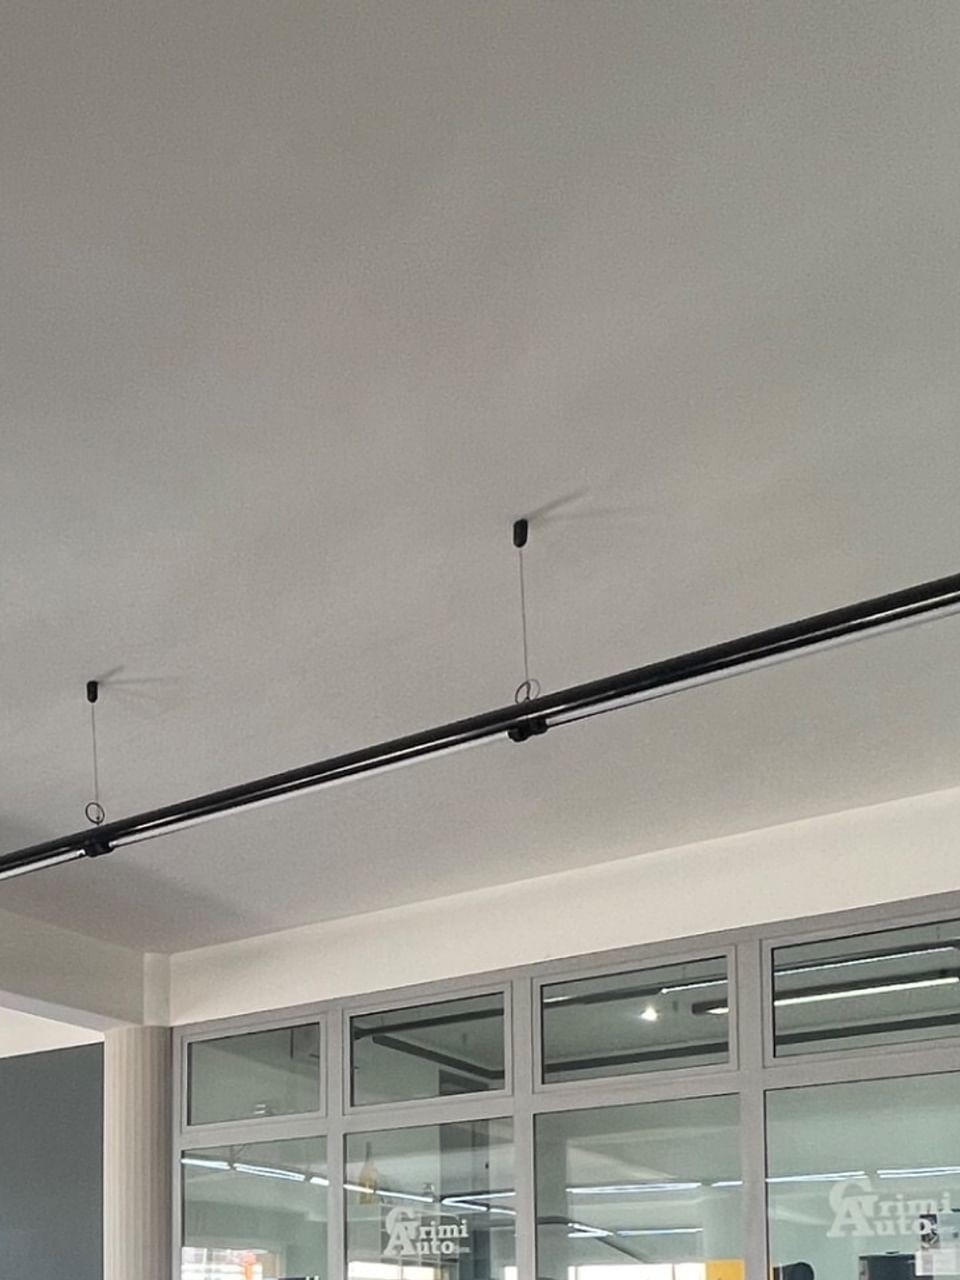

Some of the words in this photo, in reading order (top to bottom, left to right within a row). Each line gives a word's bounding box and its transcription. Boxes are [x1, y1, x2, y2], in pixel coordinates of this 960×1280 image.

[385, 1206, 469, 1240] Grimi
[826, 1197, 932, 1238] Auto
[383, 1221, 454, 1256] Auto
